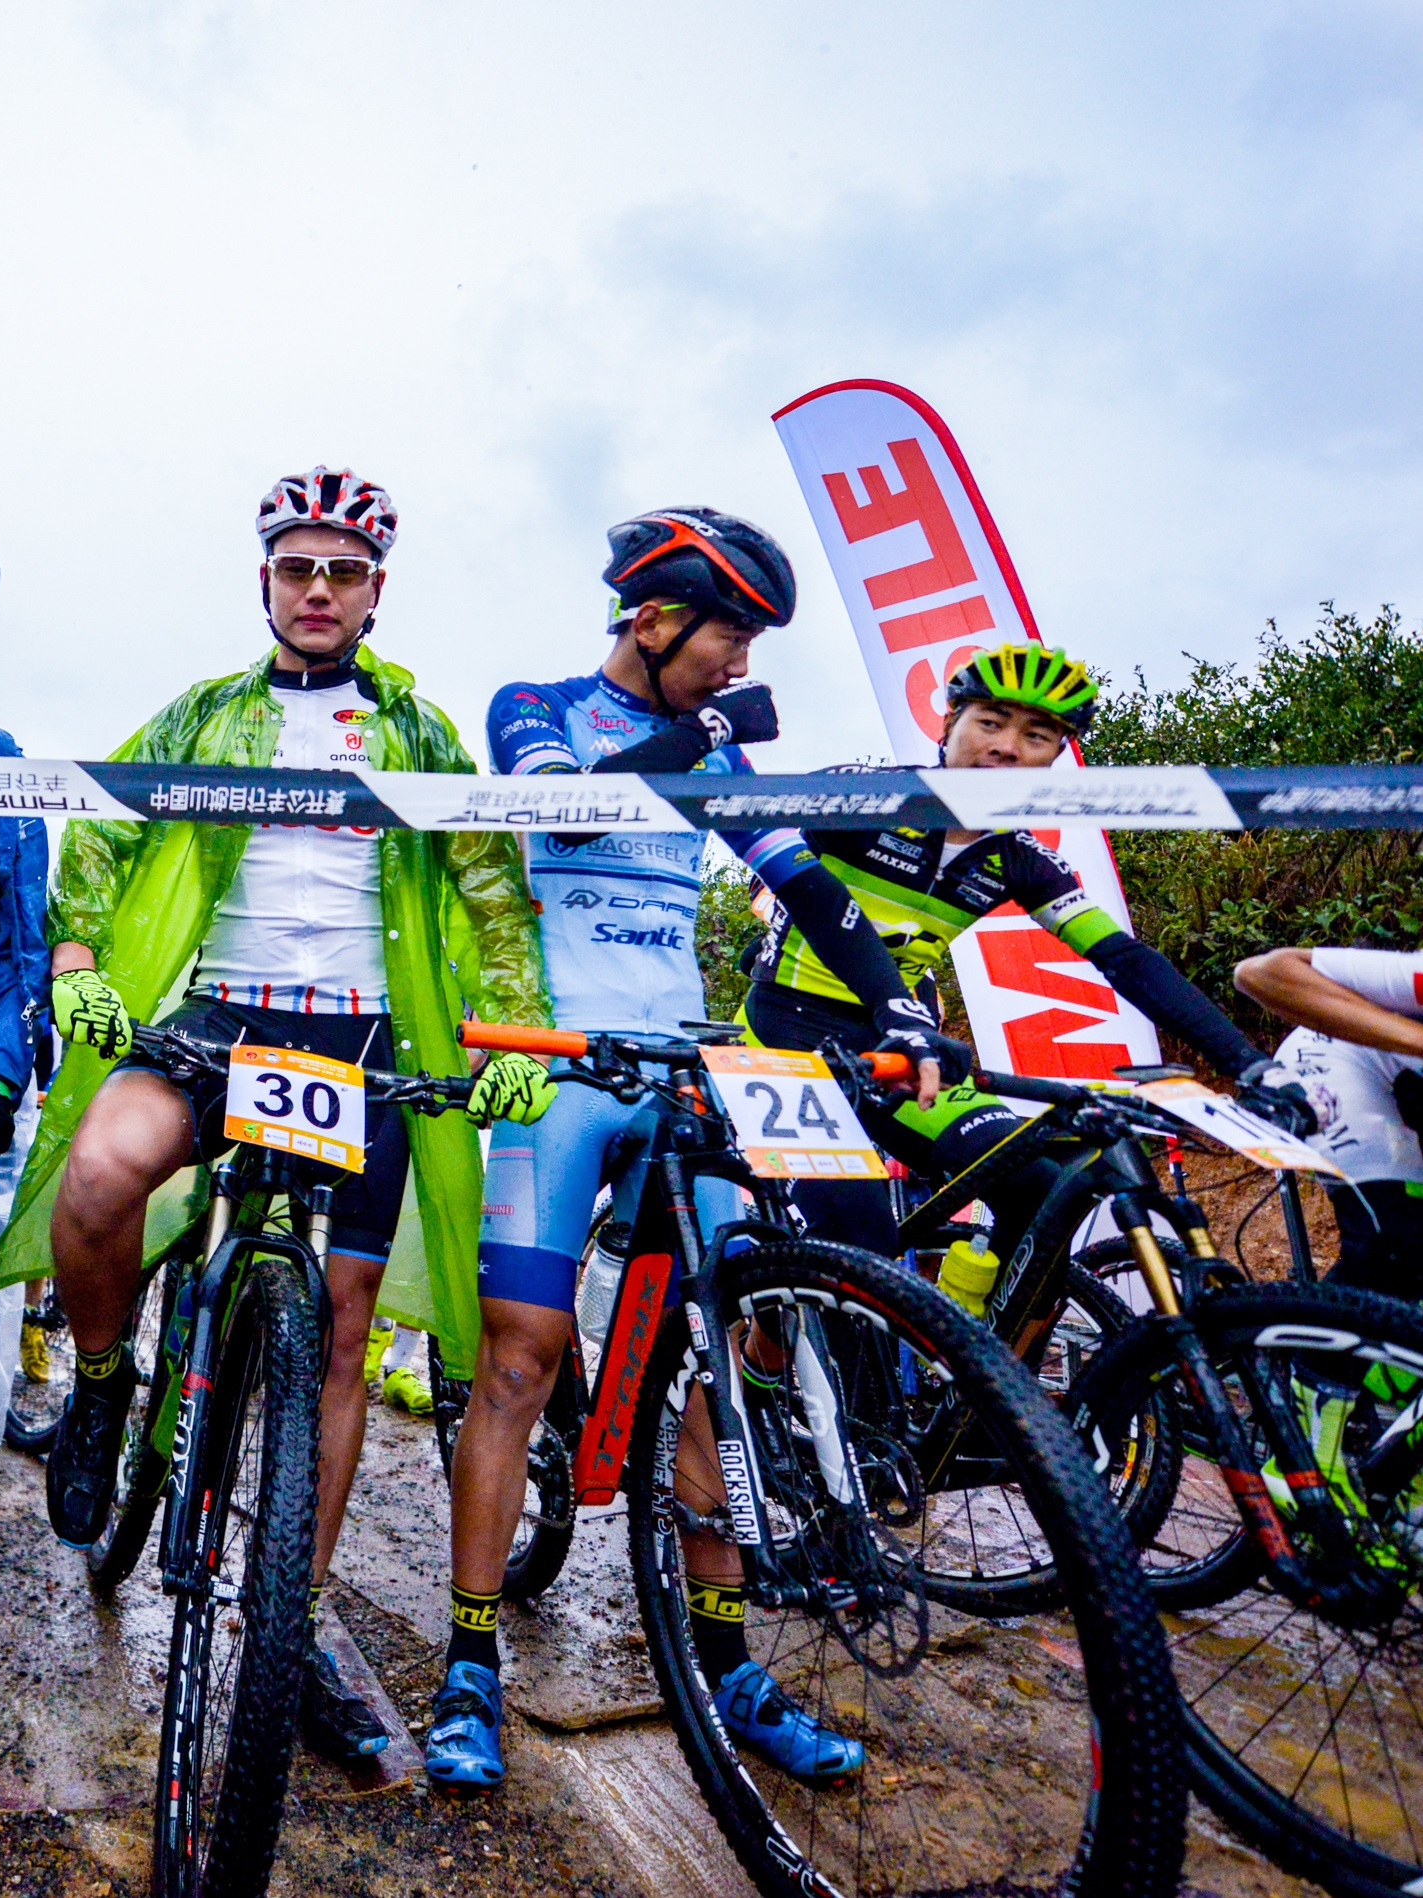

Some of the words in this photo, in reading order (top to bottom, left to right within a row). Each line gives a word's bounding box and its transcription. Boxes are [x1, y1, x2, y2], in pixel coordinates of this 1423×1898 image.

[587, 838, 682, 863] BAOSTEEL
[865, 848, 920, 875] MAXXIS
[591, 922, 685, 950] Santic
[253, 1073, 340, 1130] 30
[745, 1081, 840, 1140] 24
[959, 1110, 1017, 1136] MAXXIS
[719, 1440, 760, 1543] ROCKSHOX
